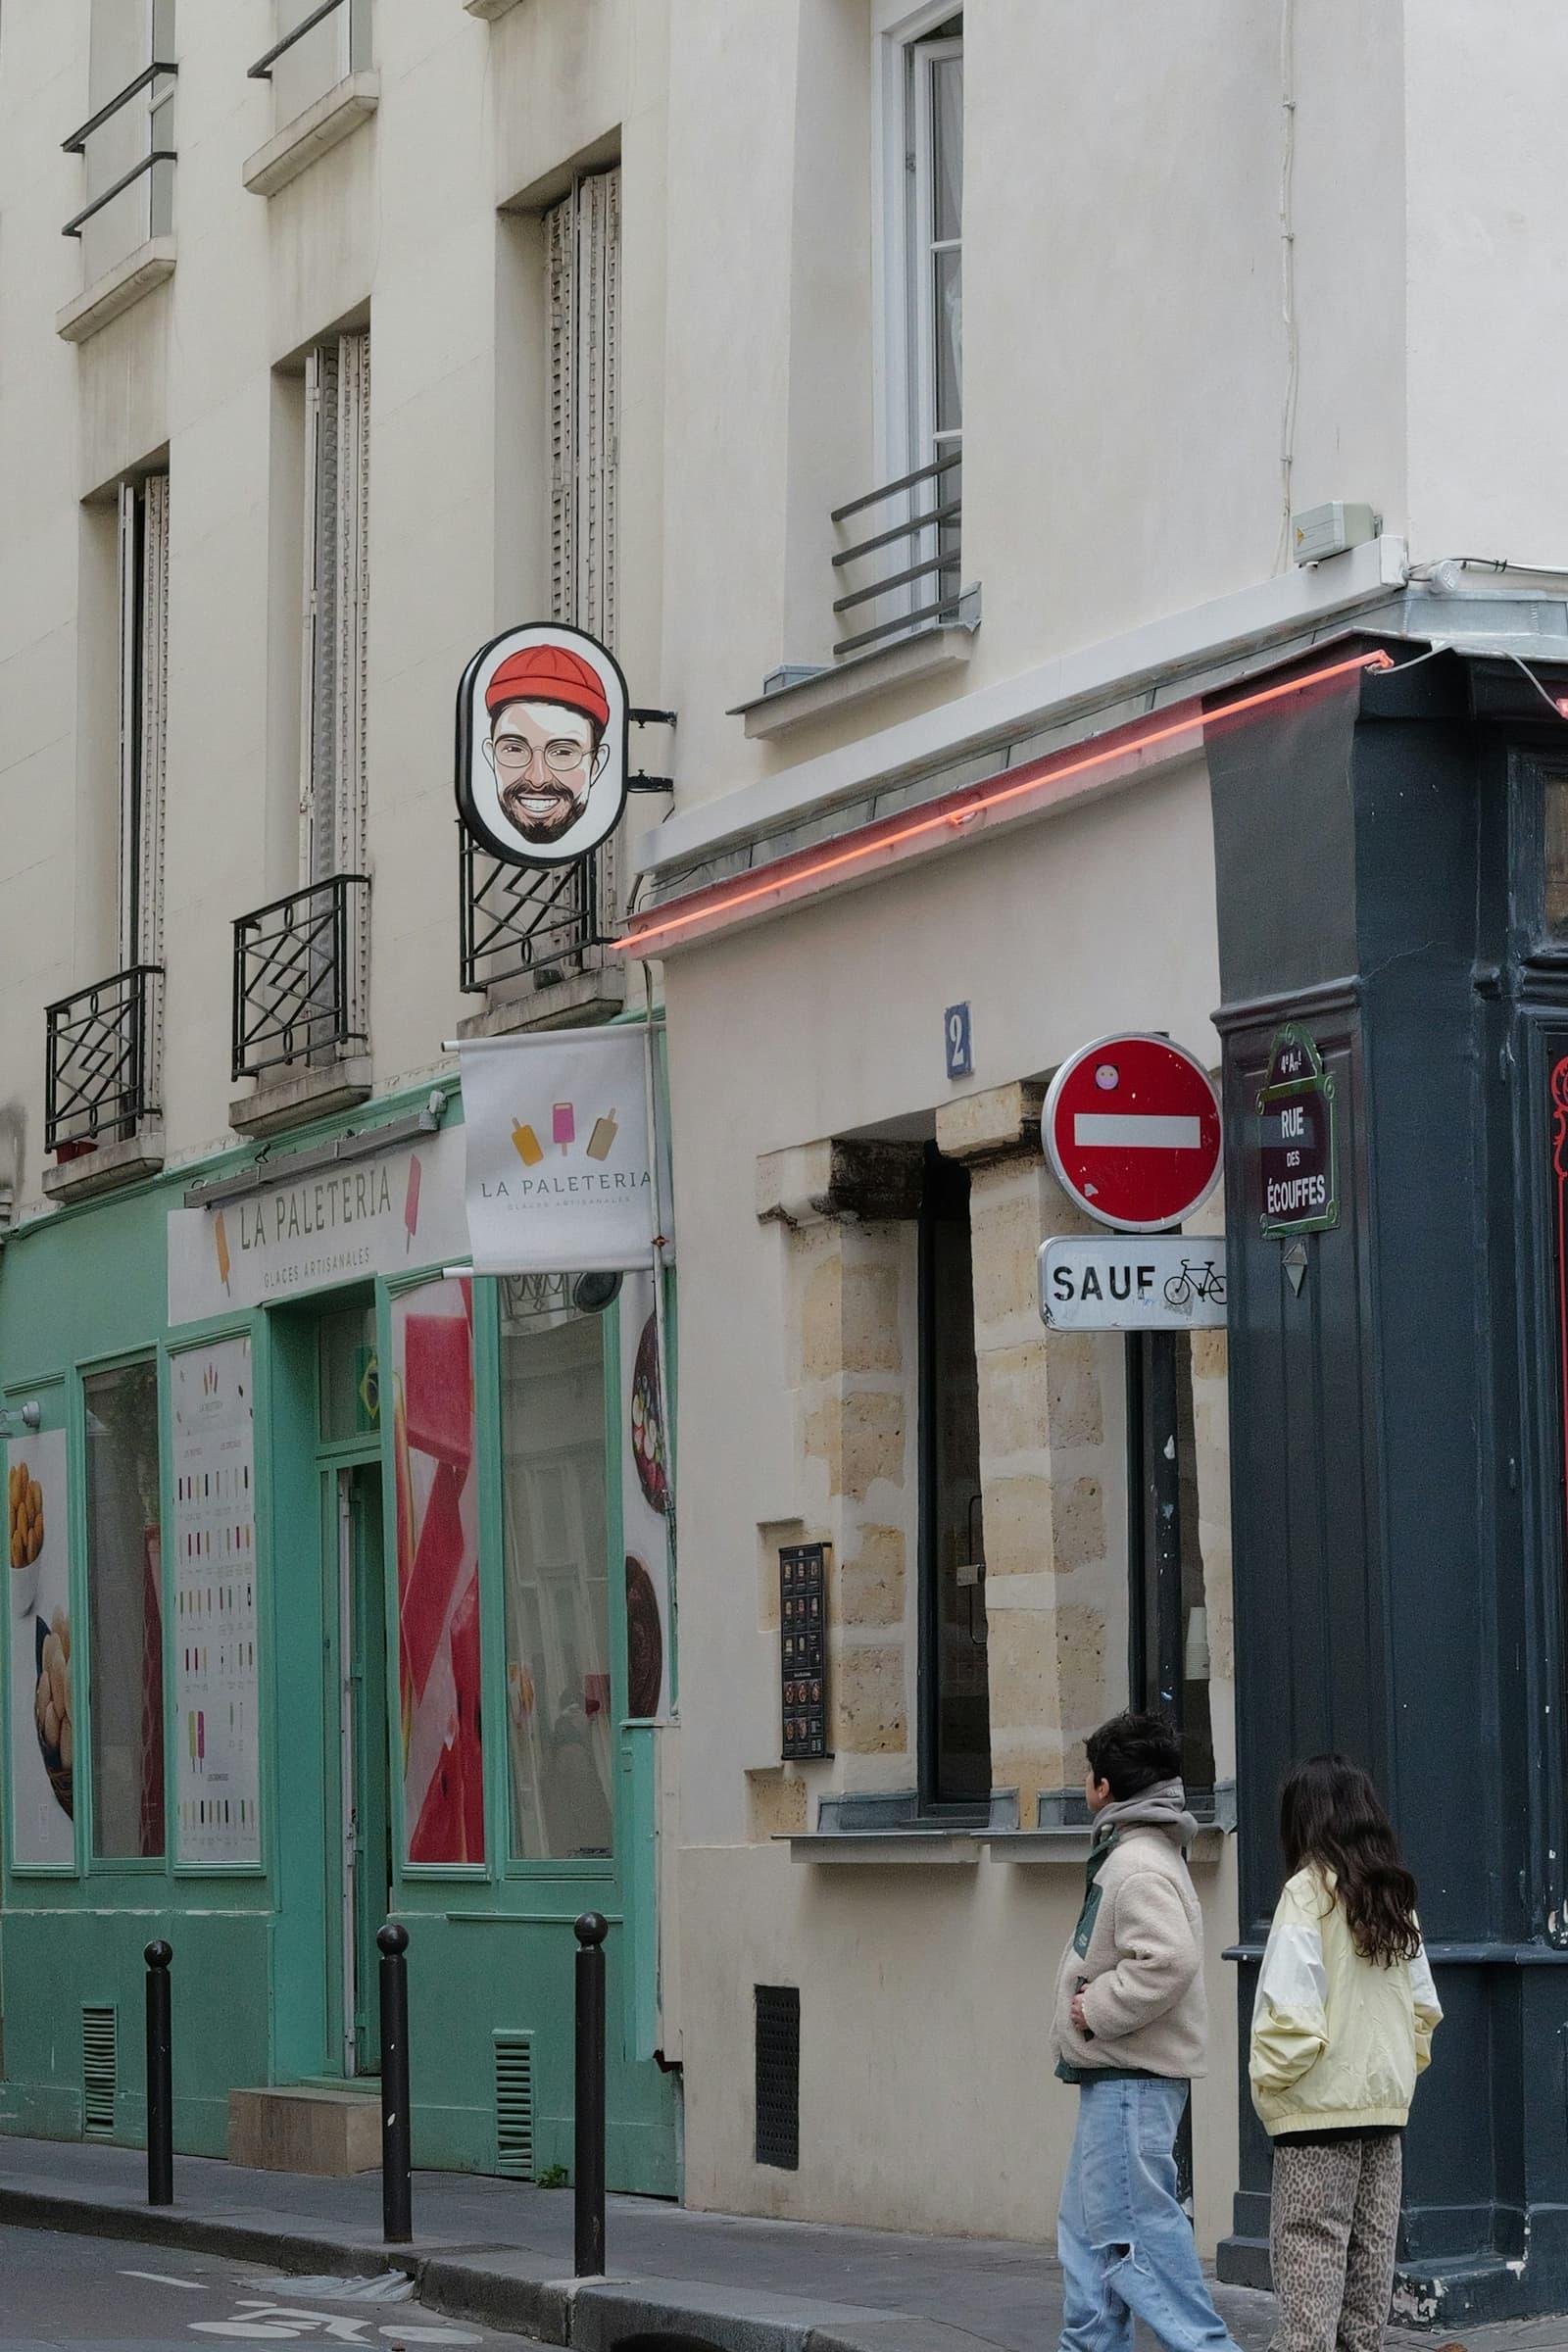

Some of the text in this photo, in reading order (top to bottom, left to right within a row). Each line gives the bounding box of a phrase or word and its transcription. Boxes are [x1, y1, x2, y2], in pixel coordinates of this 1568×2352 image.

[949, 1014, 964, 1067] 2
[1281, 1105, 1304, 1139] RUE
[1286, 1151, 1300, 1168] DES
[481, 1171, 651, 1198] LA PALETERIA
[1267, 1174, 1326, 1214] ÉCOUFFES
[240, 1165, 391, 1250] LA PALETERIA
[264, 1247, 369, 1289] GLACES ARTISANALES
[1053, 1265, 1155, 1301] SAUF
